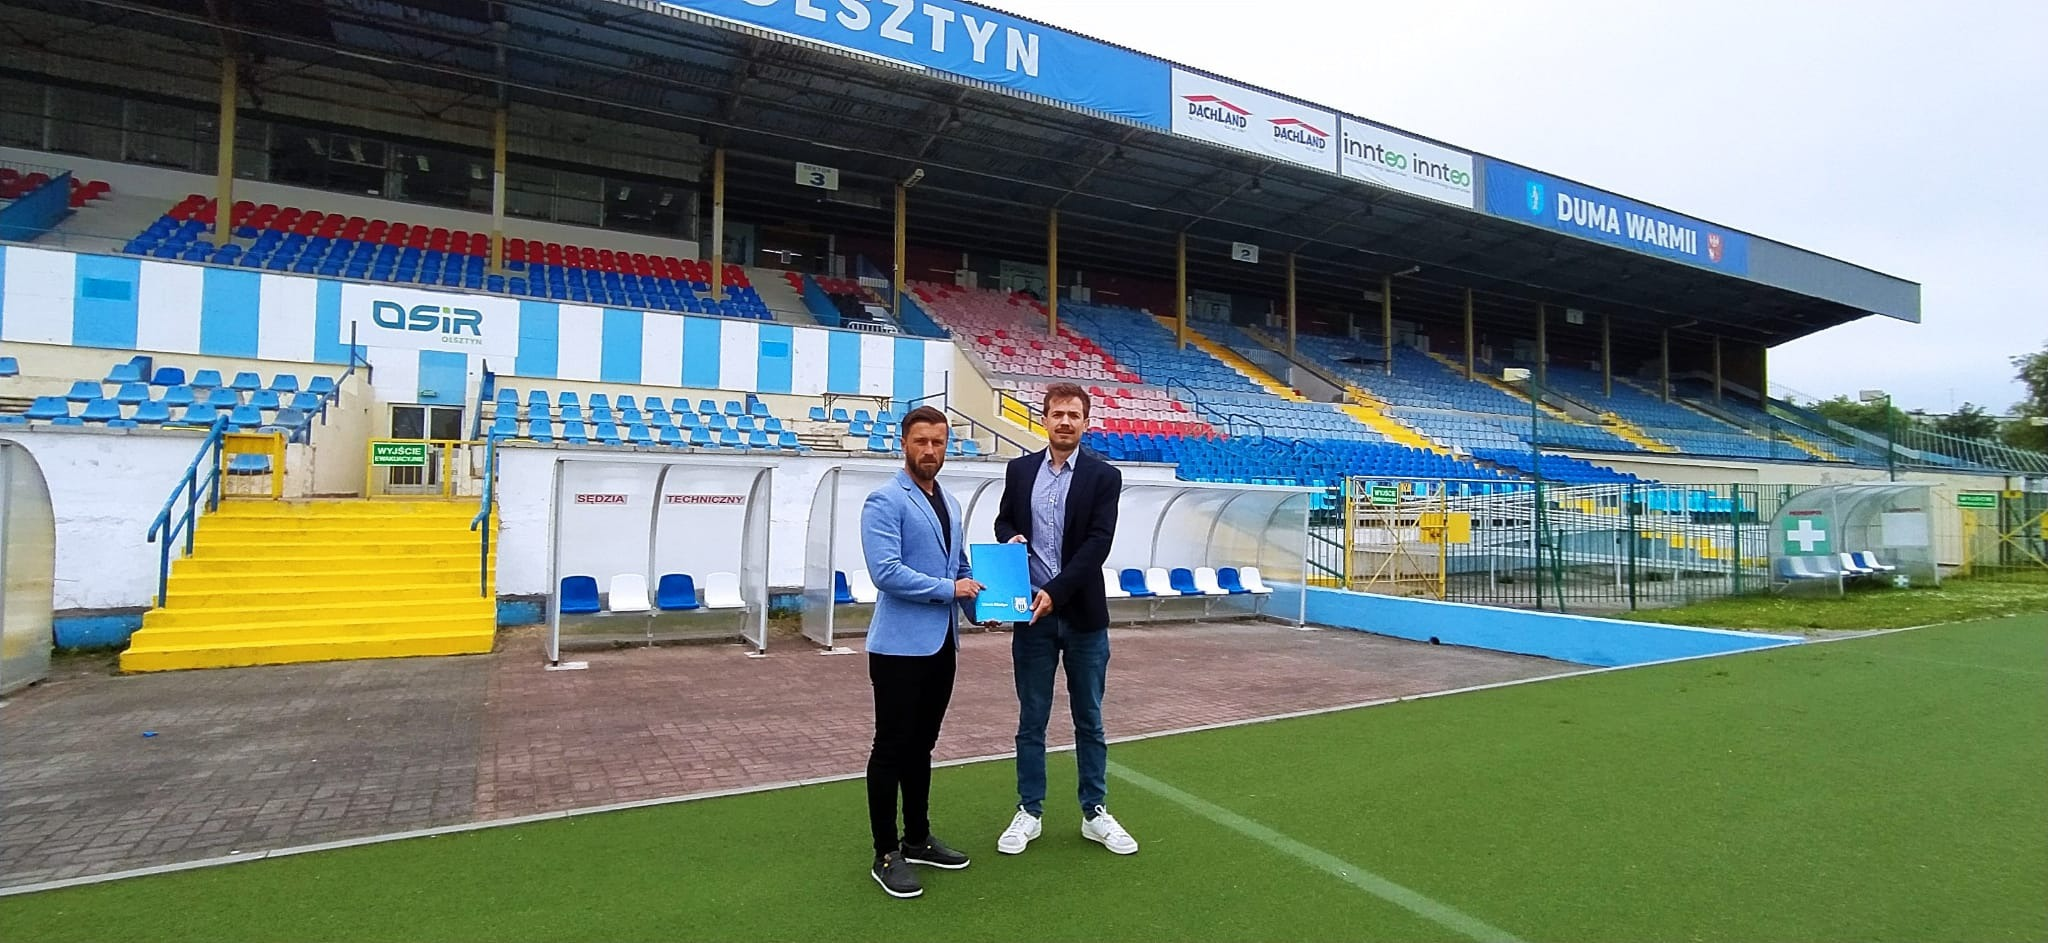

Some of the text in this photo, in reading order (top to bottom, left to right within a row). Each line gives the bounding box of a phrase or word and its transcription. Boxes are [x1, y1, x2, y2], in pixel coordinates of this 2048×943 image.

[743, 0, 1039, 77] LSZTYN
[1343, 132, 1407, 170] innteo
[1413, 152, 1471, 187] innteo
[809, 172, 825, 187] 3
[1557, 192, 1697, 255] DUMA WARMII
[1240, 248, 1251, 260] 2
[441, 336, 483, 345] OLSZTYN
[377, 446, 422, 455] WYJŚCIE
[577, 494, 744, 504] SĘDZIA TECHNICZNY
